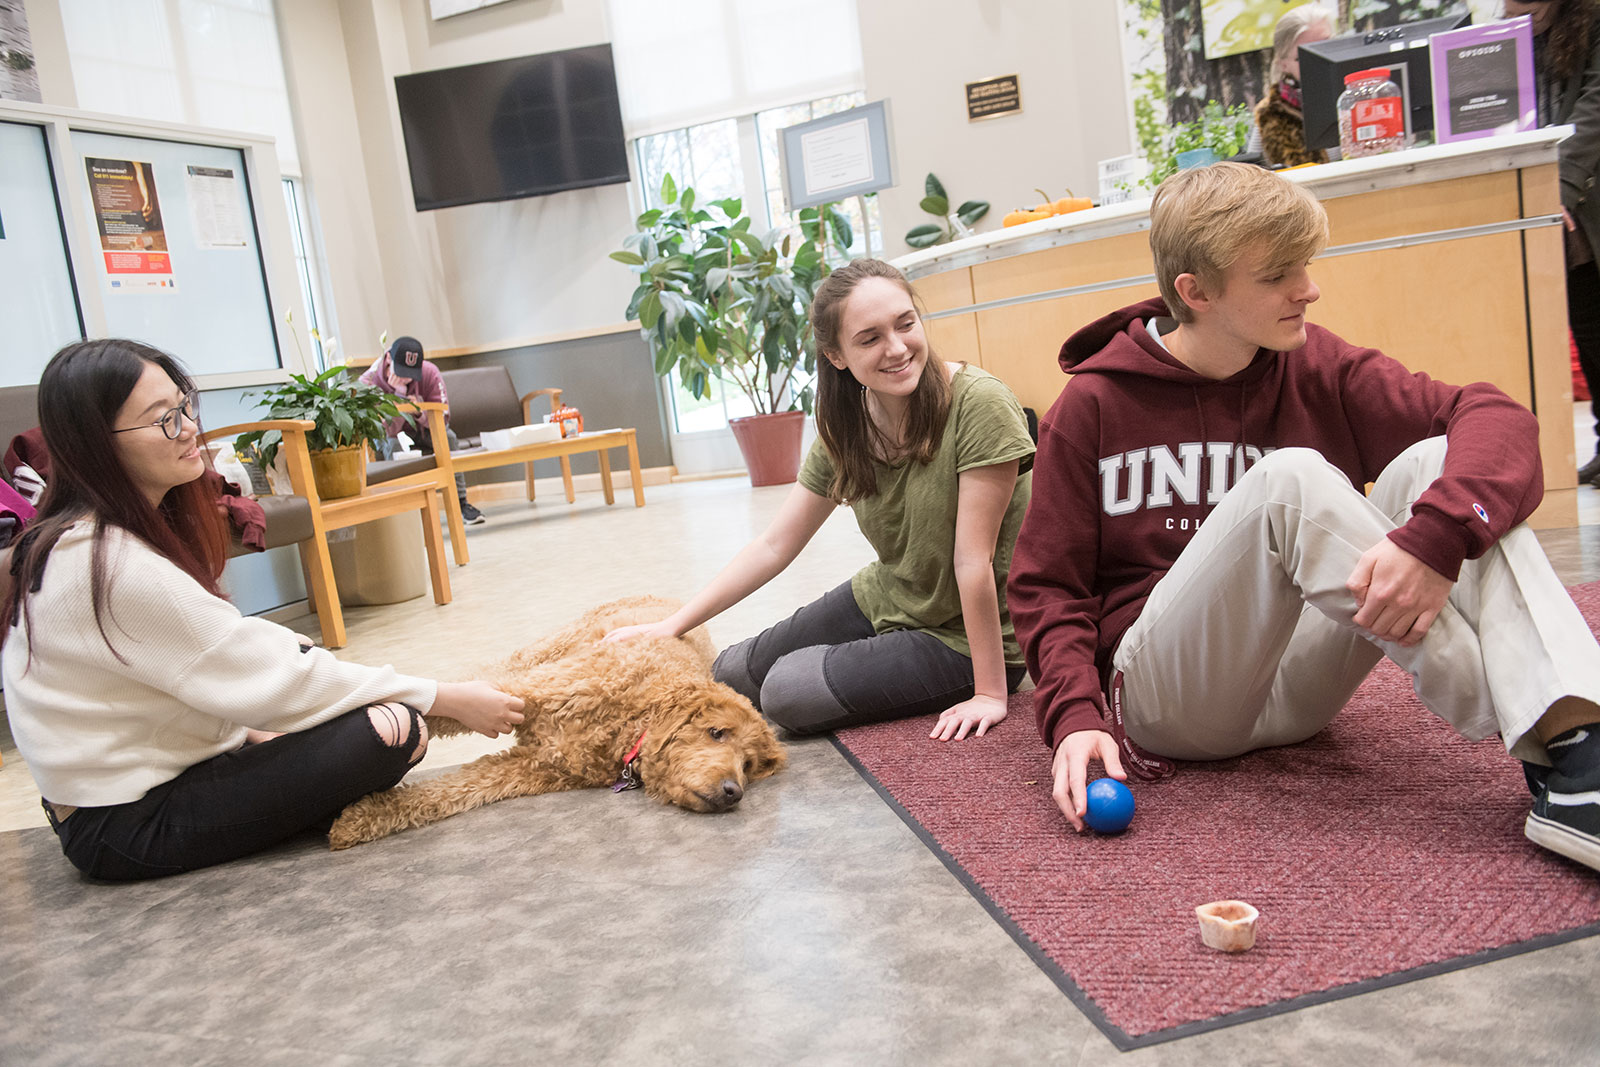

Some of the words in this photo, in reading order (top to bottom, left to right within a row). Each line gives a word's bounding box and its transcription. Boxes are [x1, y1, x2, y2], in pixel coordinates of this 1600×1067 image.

[1364, 27, 1405, 45] DELL
[1458, 44, 1503, 59] OPIOIDS
[405, 351, 418, 367] U
[1099, 442, 1277, 517] UNIO
